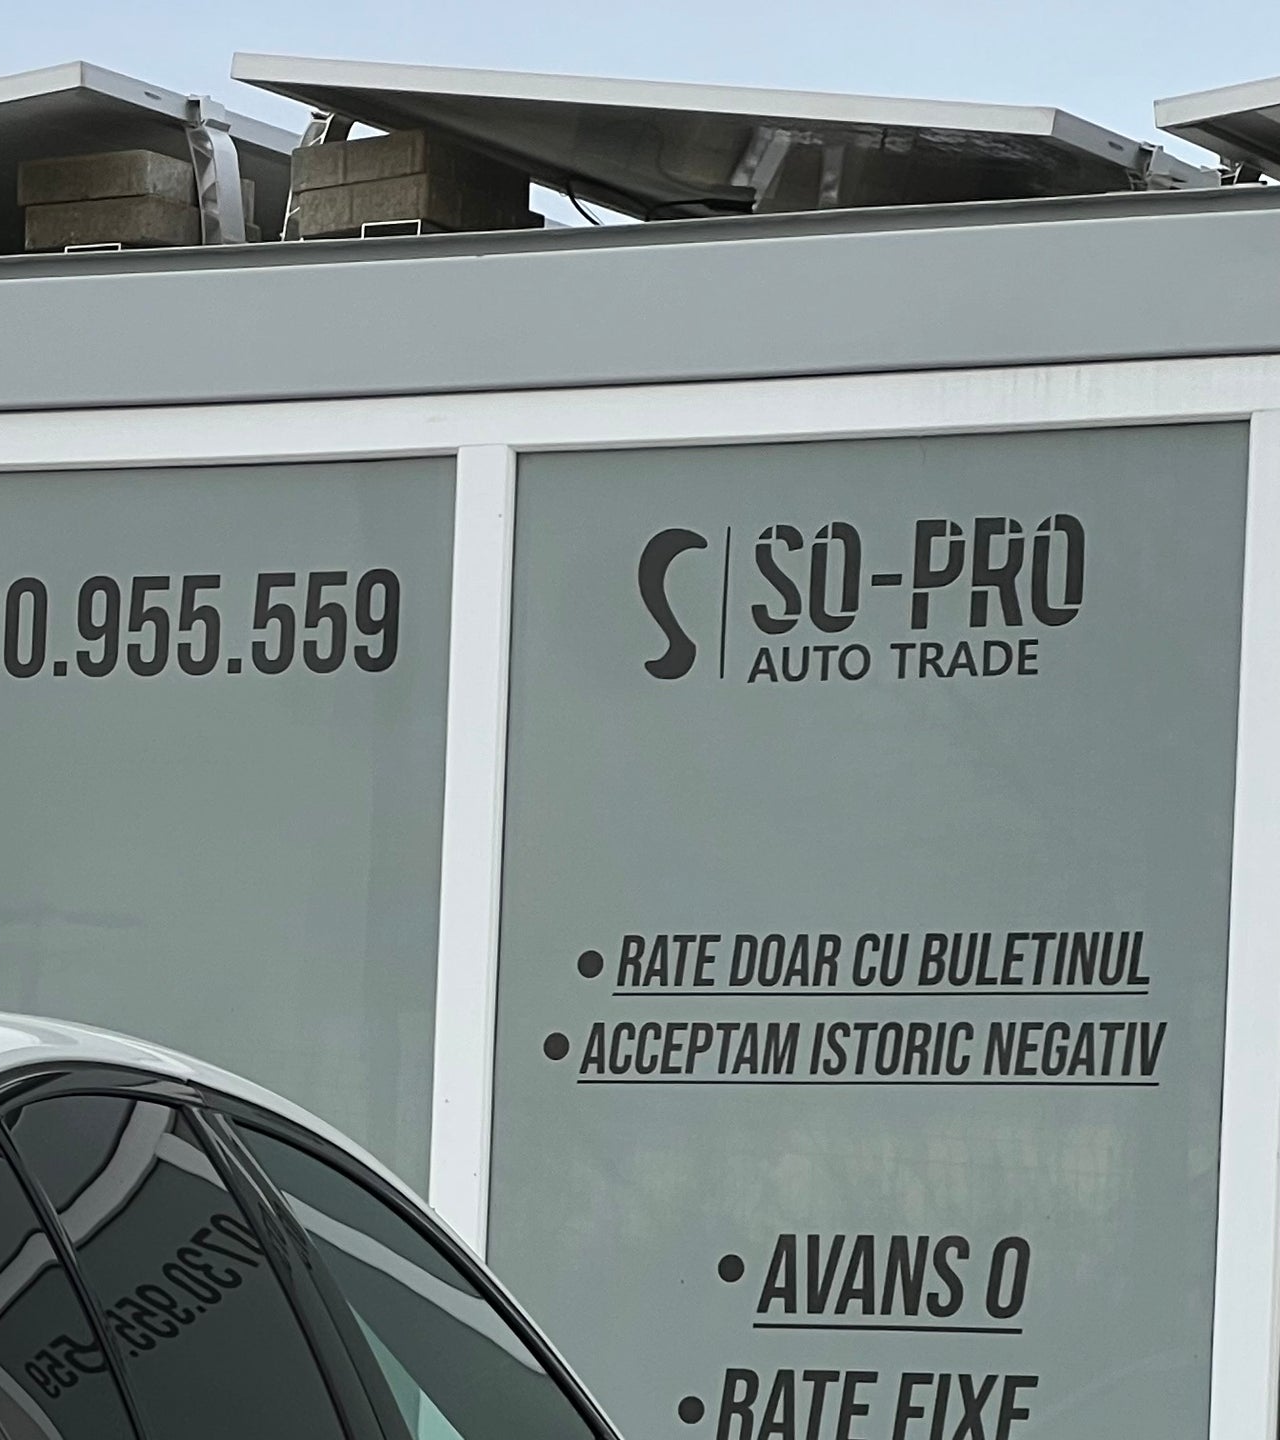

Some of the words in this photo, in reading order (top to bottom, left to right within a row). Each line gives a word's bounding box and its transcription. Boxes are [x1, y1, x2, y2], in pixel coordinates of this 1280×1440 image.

[747, 514, 1085, 634] SO-PRO
[747, 643, 871, 683] AUTO
[890, 639, 1039, 680] TRADE
[616, 934, 722, 987] RATE
[729, 933, 841, 987] DOAR
[852, 933, 910, 987] CU
[917, 931, 1151, 987] BULETINUL
[578, 1021, 801, 1075] ACCEPTAM
[809, 1021, 974, 1076] ISTORIC
[983, 1021, 1168, 1077] NEGATIV
[756, 1233, 970, 1318] AVANS
